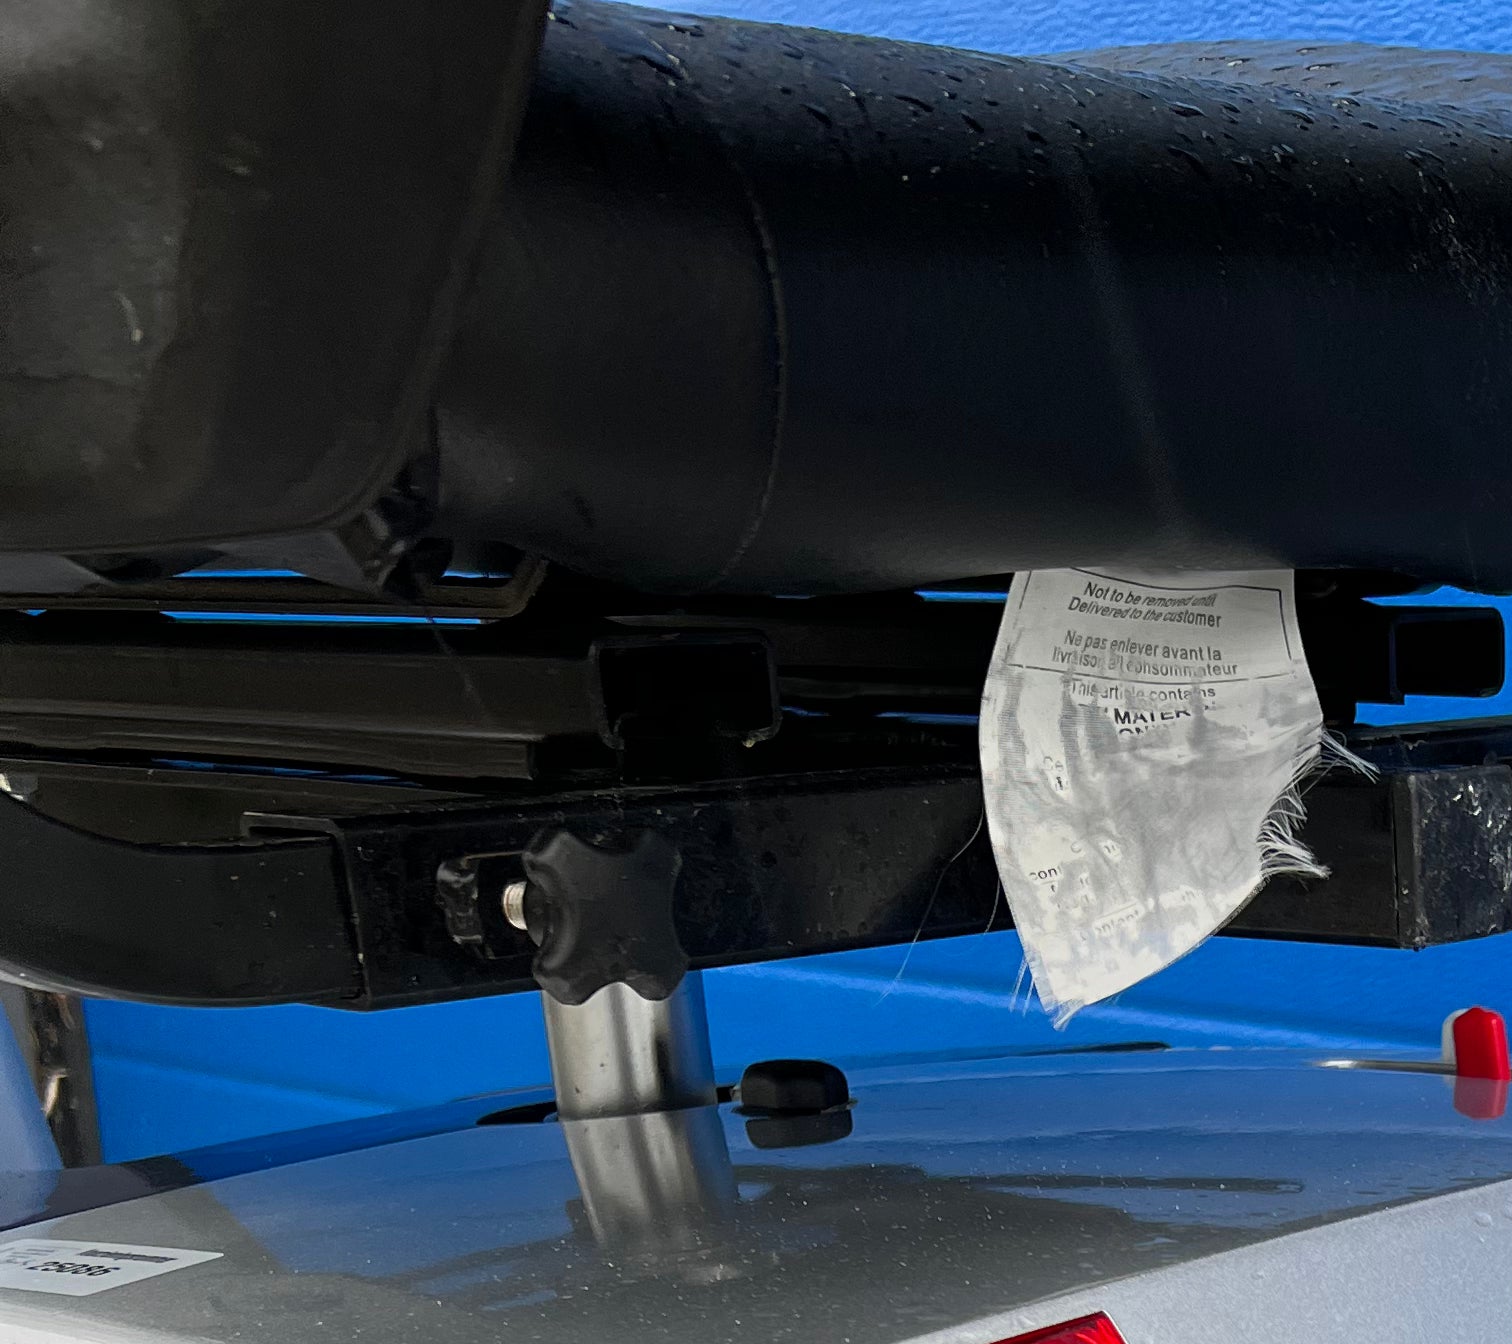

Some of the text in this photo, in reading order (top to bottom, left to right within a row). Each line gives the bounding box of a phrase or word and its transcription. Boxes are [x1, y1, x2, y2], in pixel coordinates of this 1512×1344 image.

[1083, 581, 1108, 598] Not
[1110, 590, 1123, 603] to
[1127, 592, 1141, 605] be
[1142, 594, 1193, 607] removed
[1068, 596, 1221, 628] Delivered to the customer
[1064, 630, 1222, 661] Ne pas enlever avant la
[1151, 688, 1216, 701] contans
[25, 1261, 121, 1277] 25086
